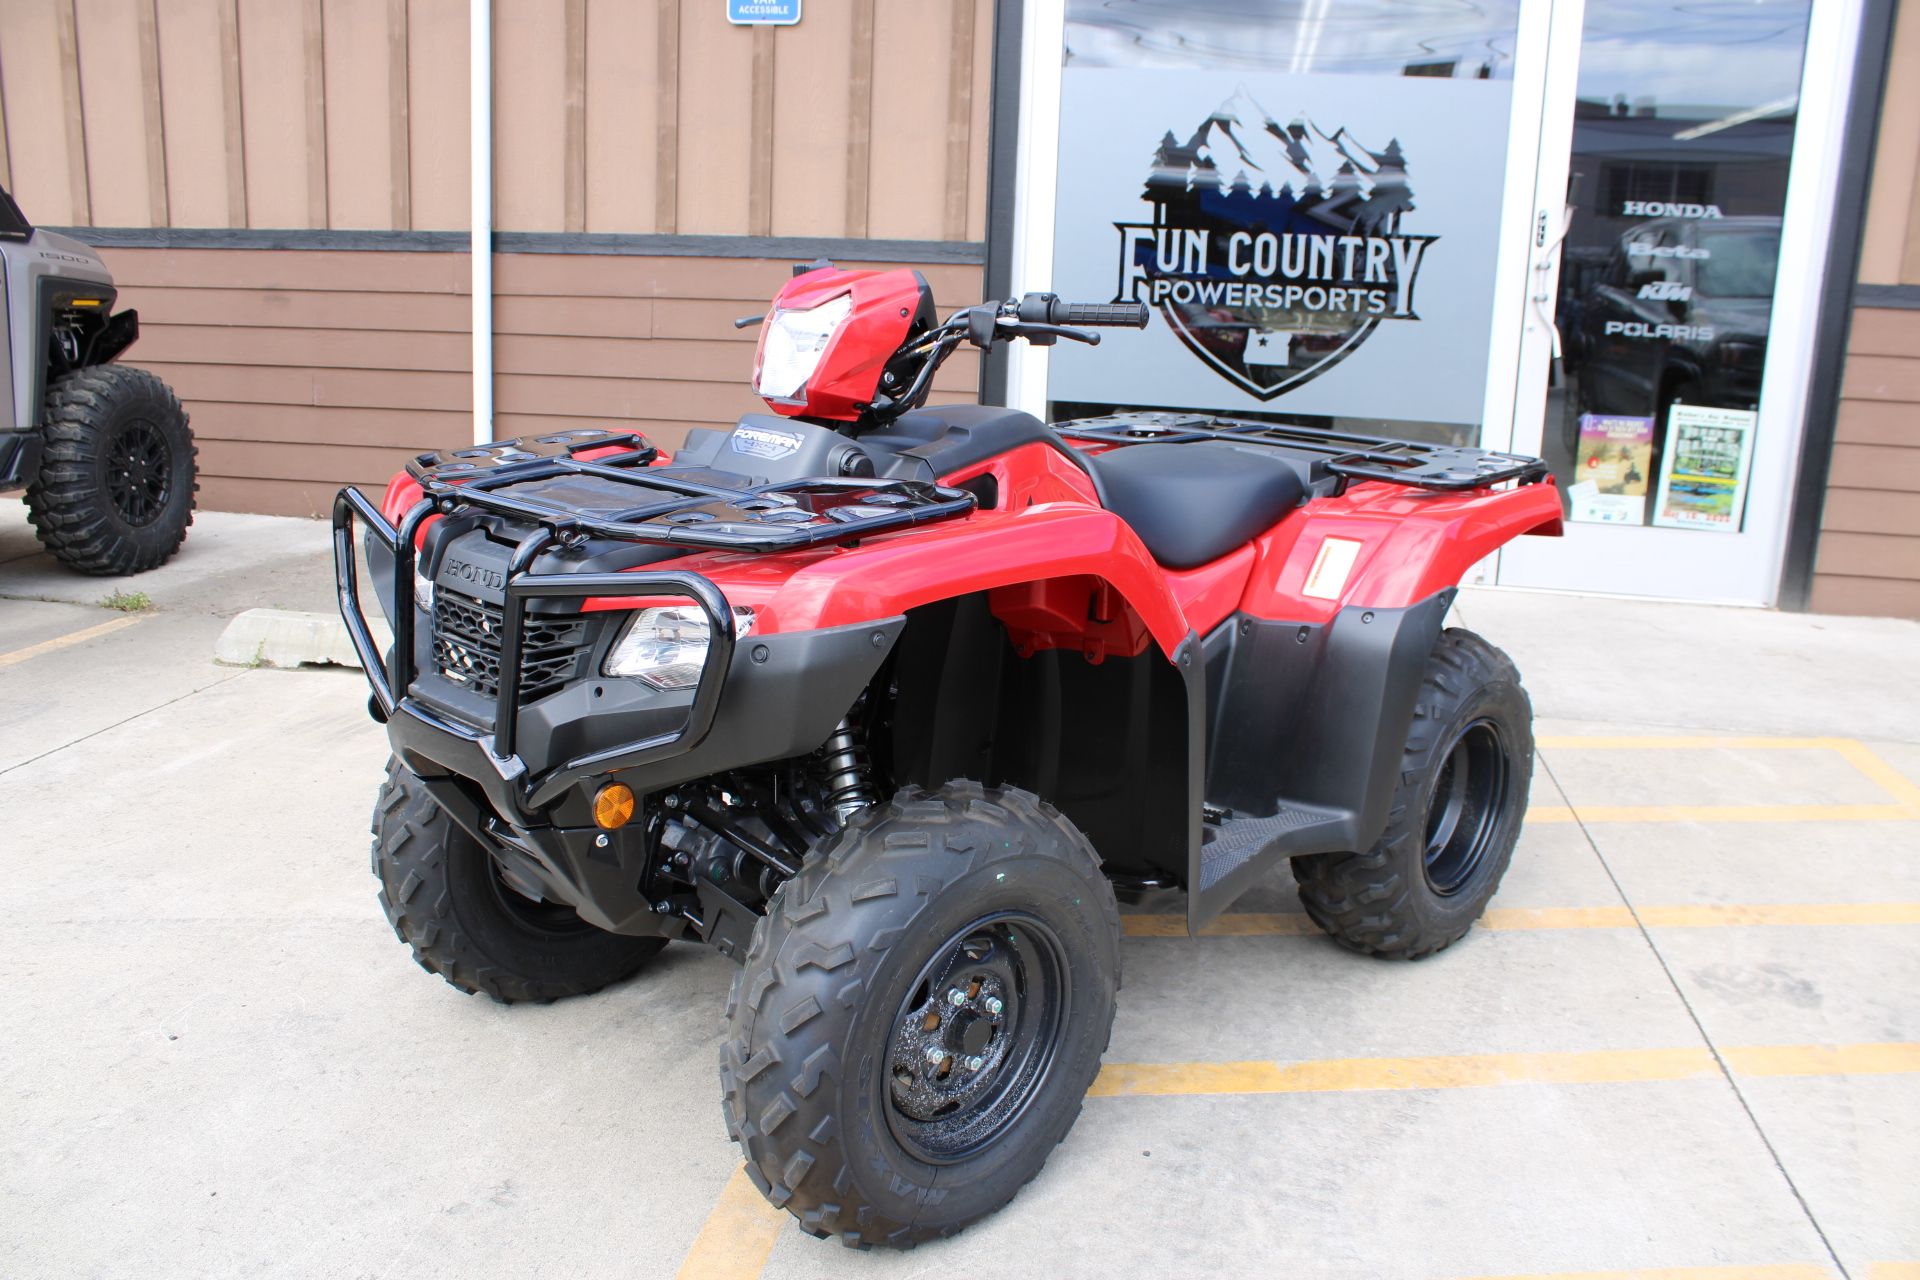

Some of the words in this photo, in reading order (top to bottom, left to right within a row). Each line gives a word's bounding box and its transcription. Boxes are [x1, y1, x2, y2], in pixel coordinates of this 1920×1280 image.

[738, 5, 789, 15] ACCESSIBLE
[1623, 200, 1724, 220] HONDA
[1628, 242, 1711, 260] Beta
[1119, 225, 1210, 303] FUN
[1227, 231, 1426, 317] COUNTRY
[1152, 278, 1387, 315] POWERSPORTS
[1636, 280, 1693, 302] KTM
[1605, 320, 1715, 341] POLARIS
[733, 428, 804, 450] FOREMAN
